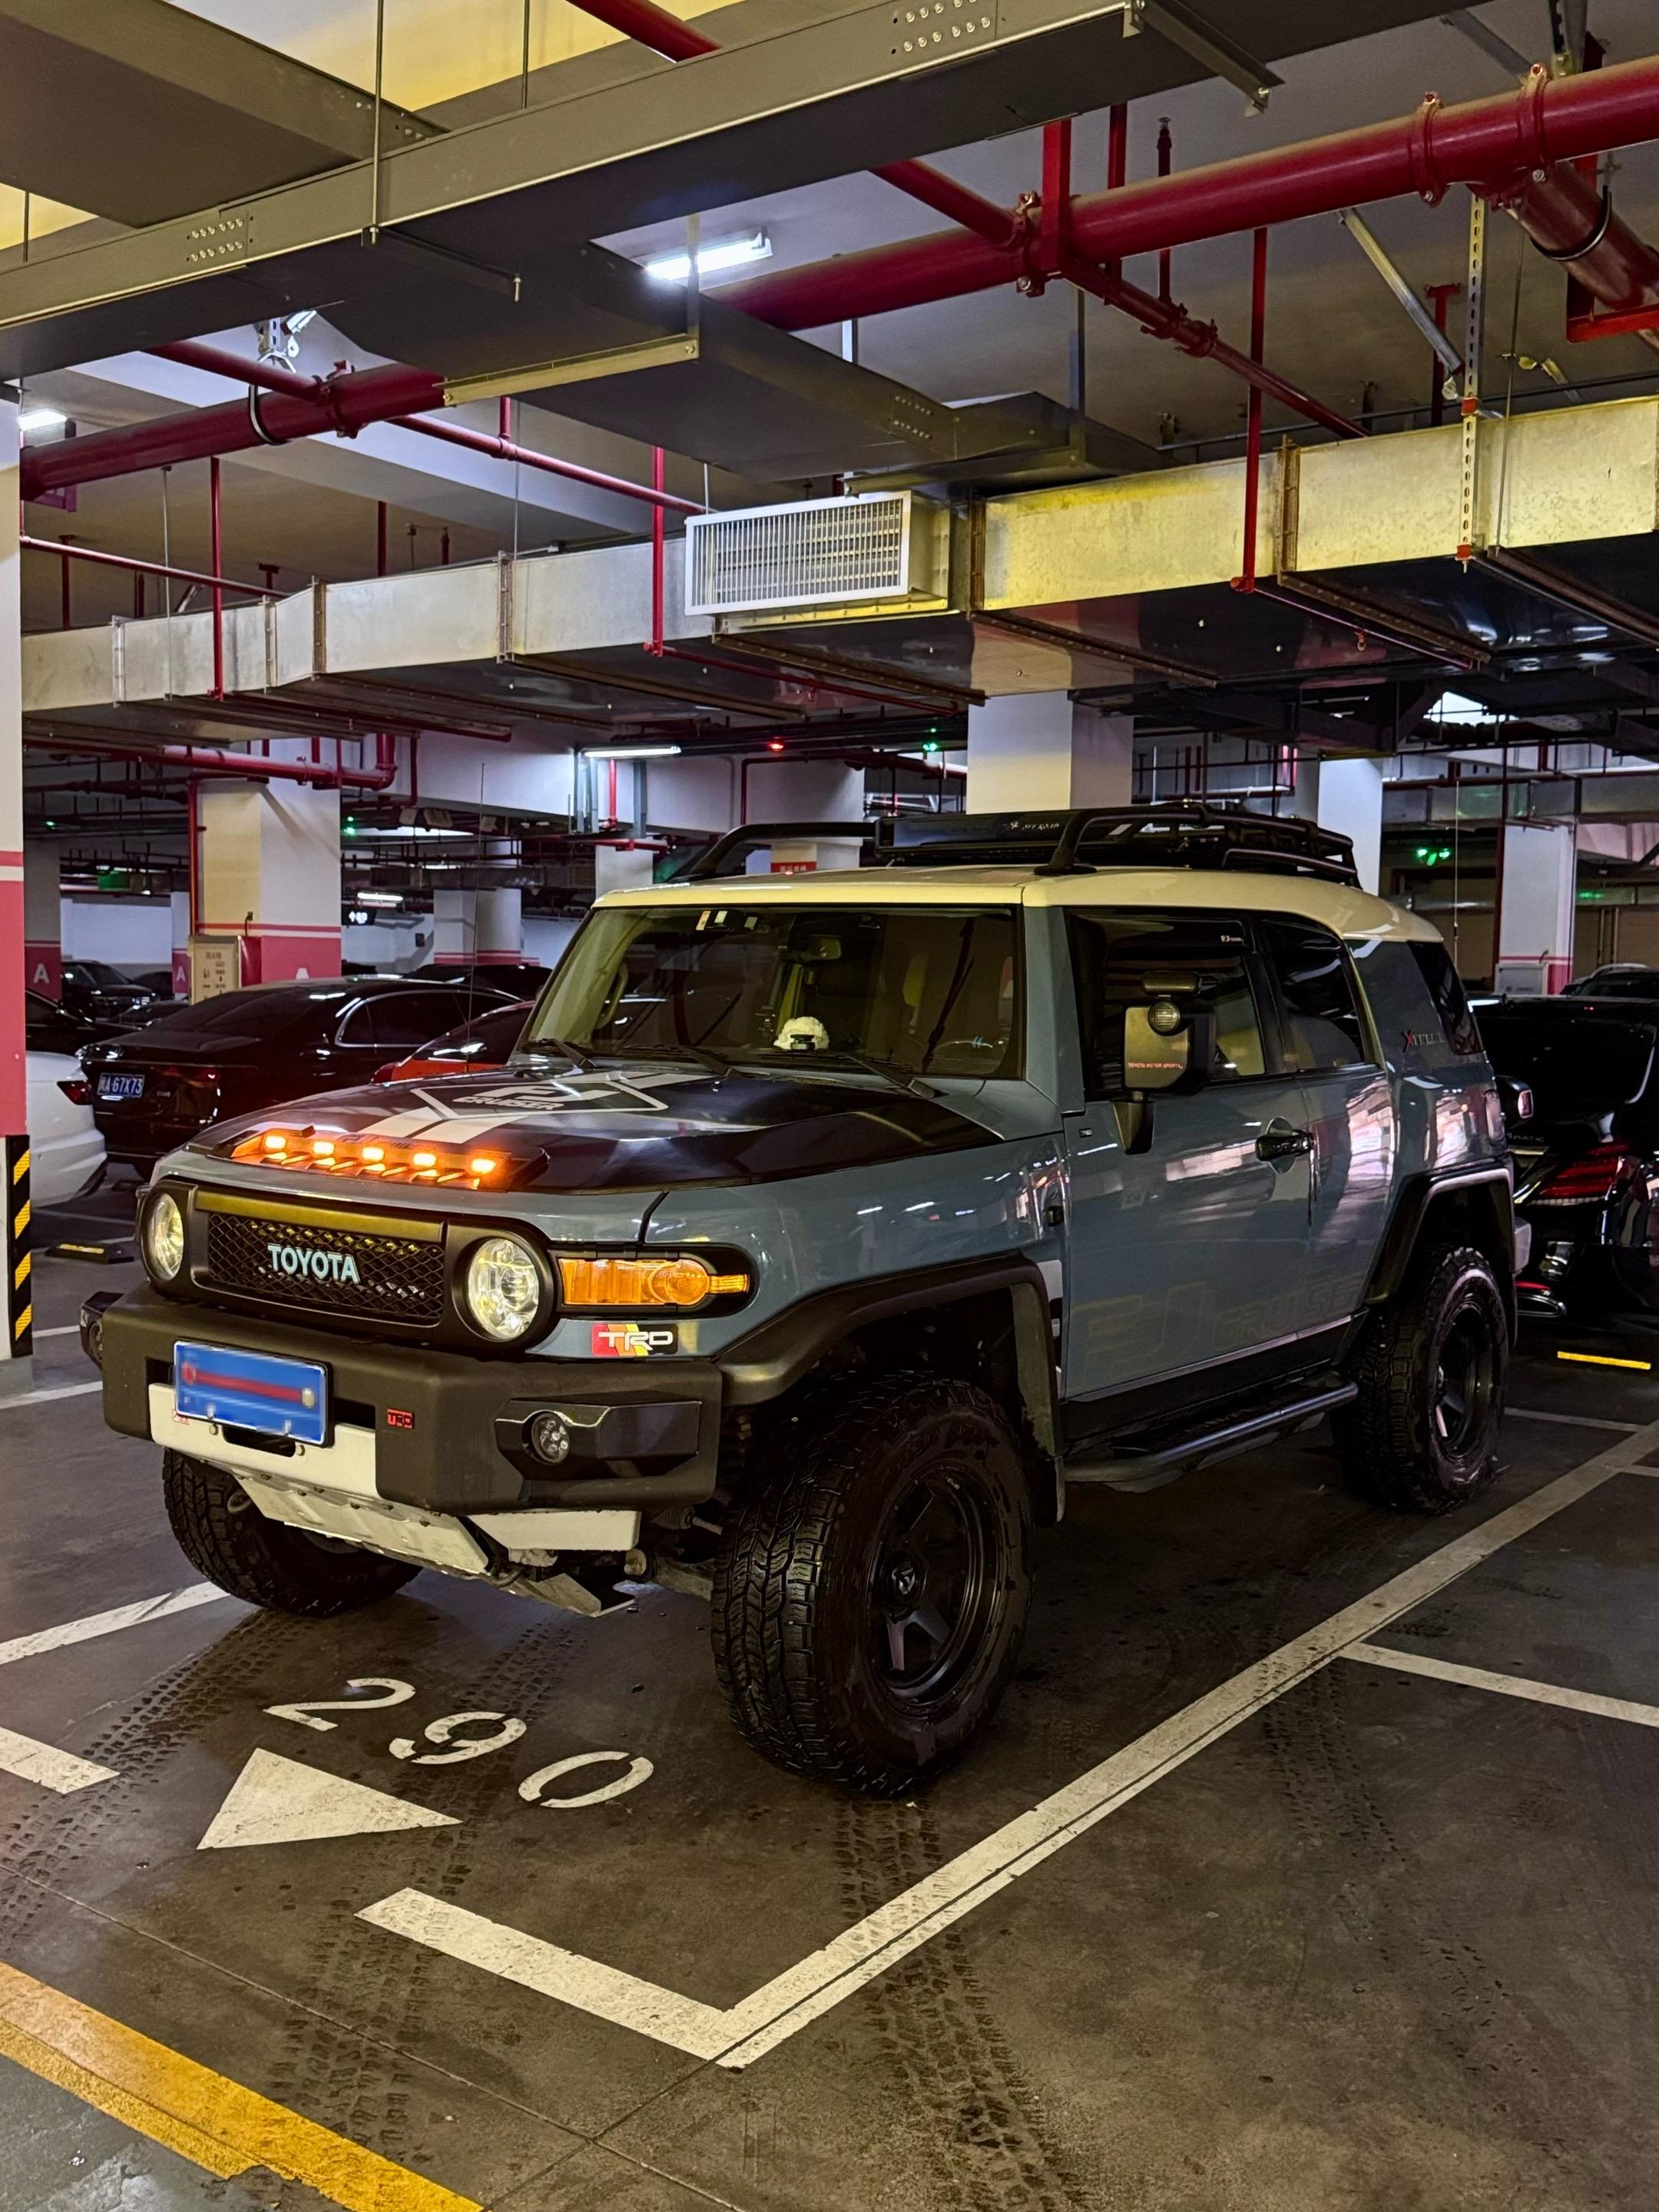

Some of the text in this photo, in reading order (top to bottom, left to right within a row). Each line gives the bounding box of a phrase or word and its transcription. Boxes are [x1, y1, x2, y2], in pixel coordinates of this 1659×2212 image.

[33, 964, 50, 983] A
[176, 965, 187, 982] A
[452, 1095, 565, 1111] CRUISER
[267, 1243, 360, 1284] TOYOTA
[598, 1331, 674, 1351] TRD
[388, 1412, 412, 1426] TRD
[263, 1677, 654, 1809] 290
